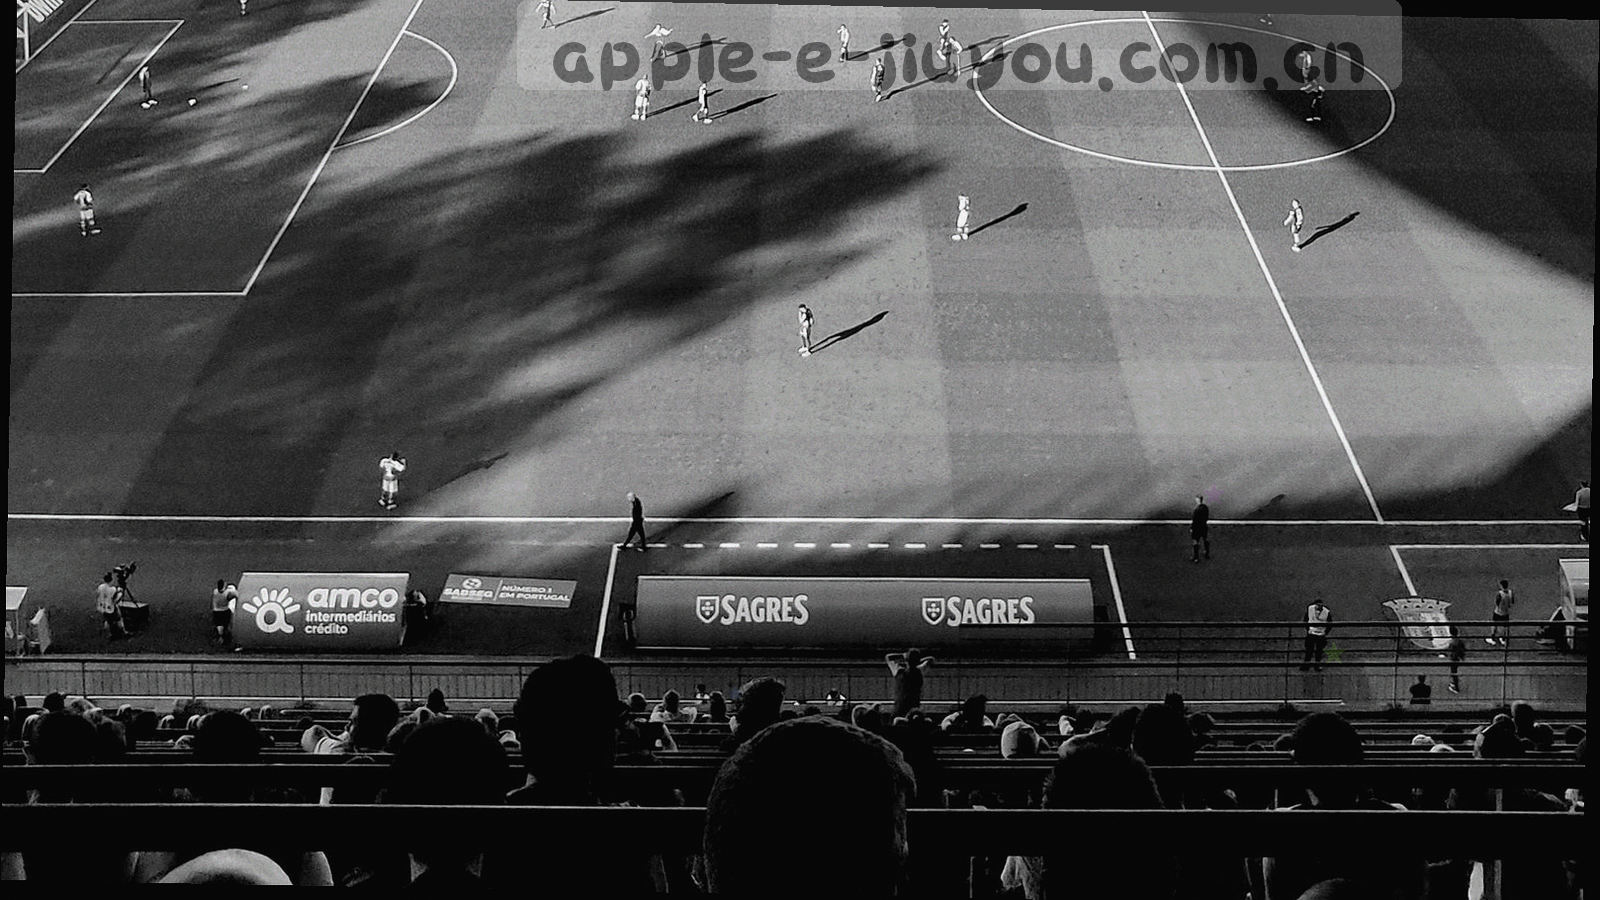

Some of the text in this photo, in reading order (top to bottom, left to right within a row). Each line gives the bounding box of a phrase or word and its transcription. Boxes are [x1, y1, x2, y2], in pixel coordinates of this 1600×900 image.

[307, 587, 399, 608] amco
[516, 592, 571, 601] PORTUGAL
[305, 609, 396, 623] intermediários
[720, 594, 809, 626] SAGRES
[946, 596, 1035, 627] SAGRES
[304, 623, 349, 635] crédito
